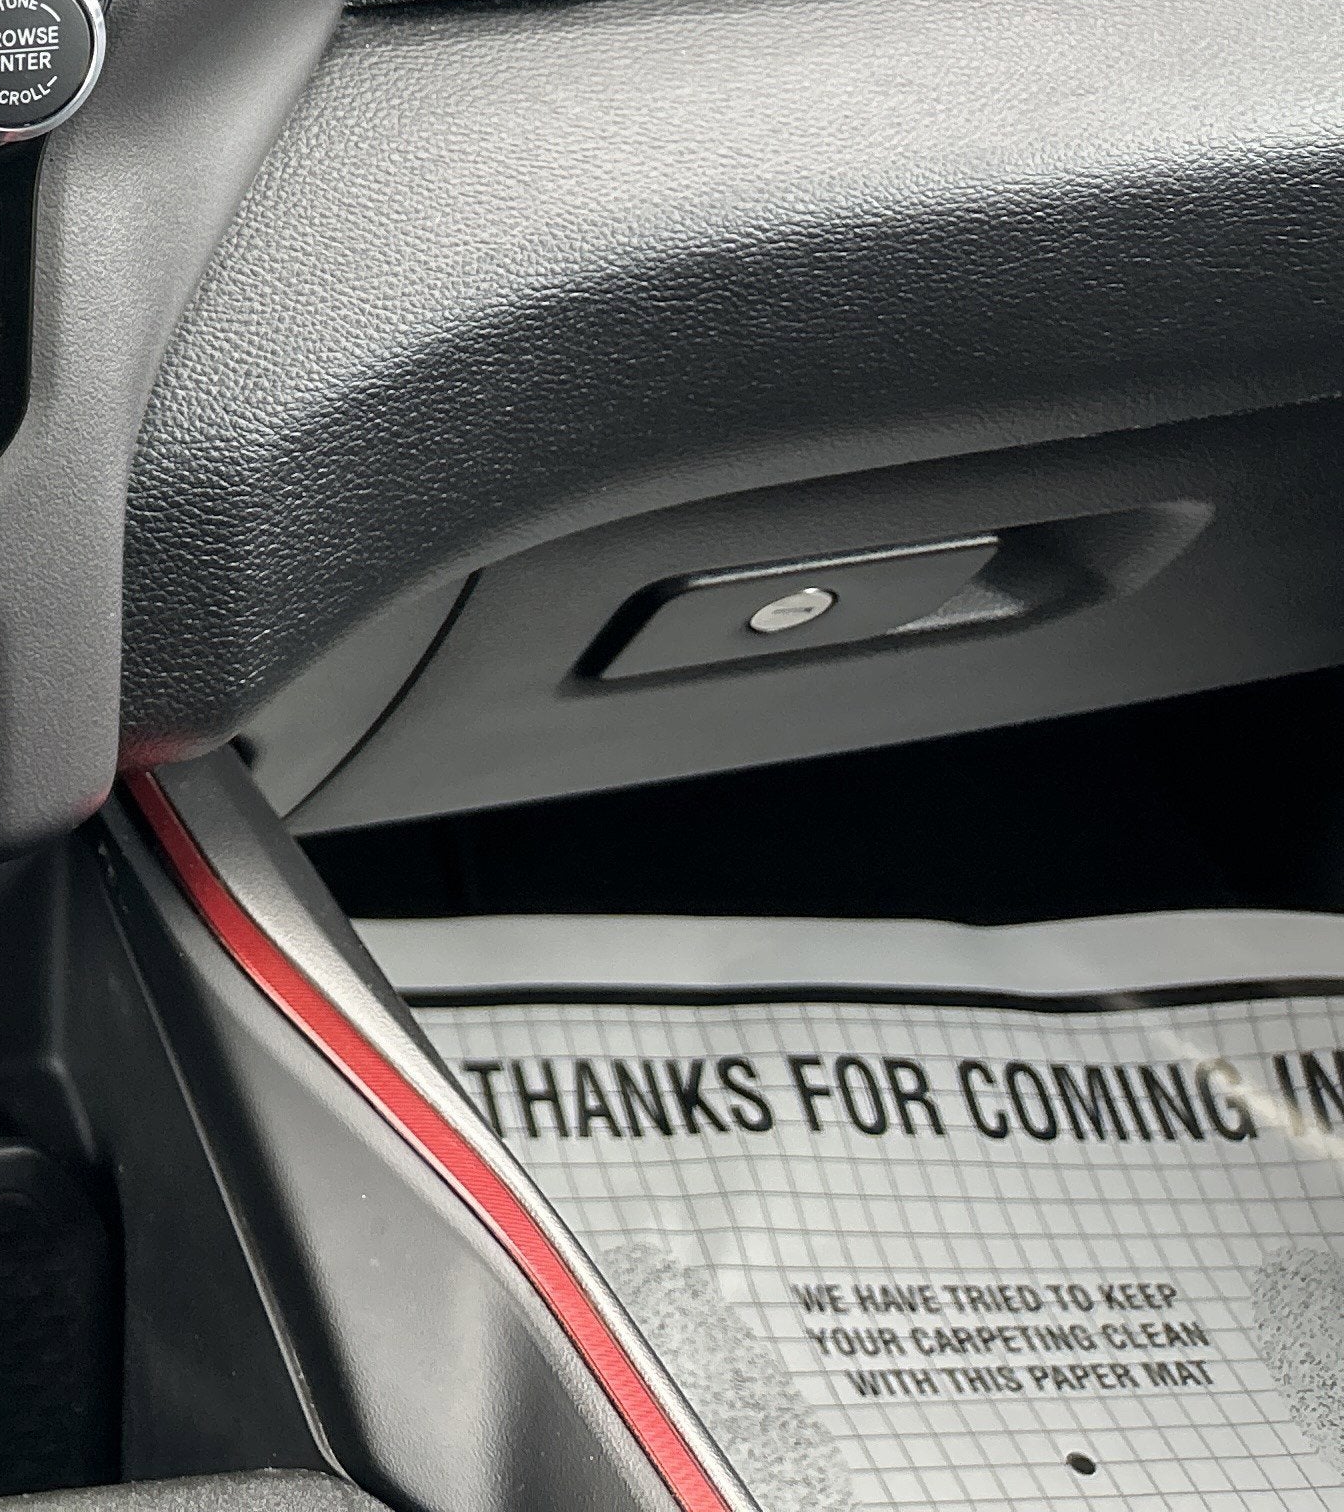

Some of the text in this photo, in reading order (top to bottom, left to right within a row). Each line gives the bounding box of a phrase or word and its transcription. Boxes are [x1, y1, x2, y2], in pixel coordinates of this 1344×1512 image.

[462, 1054, 774, 1138] THANKS
[787, 1054, 946, 1136] FOR
[959, 1058, 1258, 1142] COMING
[793, 1283, 1178, 1314] WE HAVE TRIED TO KEEP
[807, 1321, 1211, 1357] YOUR CARPETING CLEAN
[845, 1360, 1215, 1398] WITH THIS PAPER MAT
